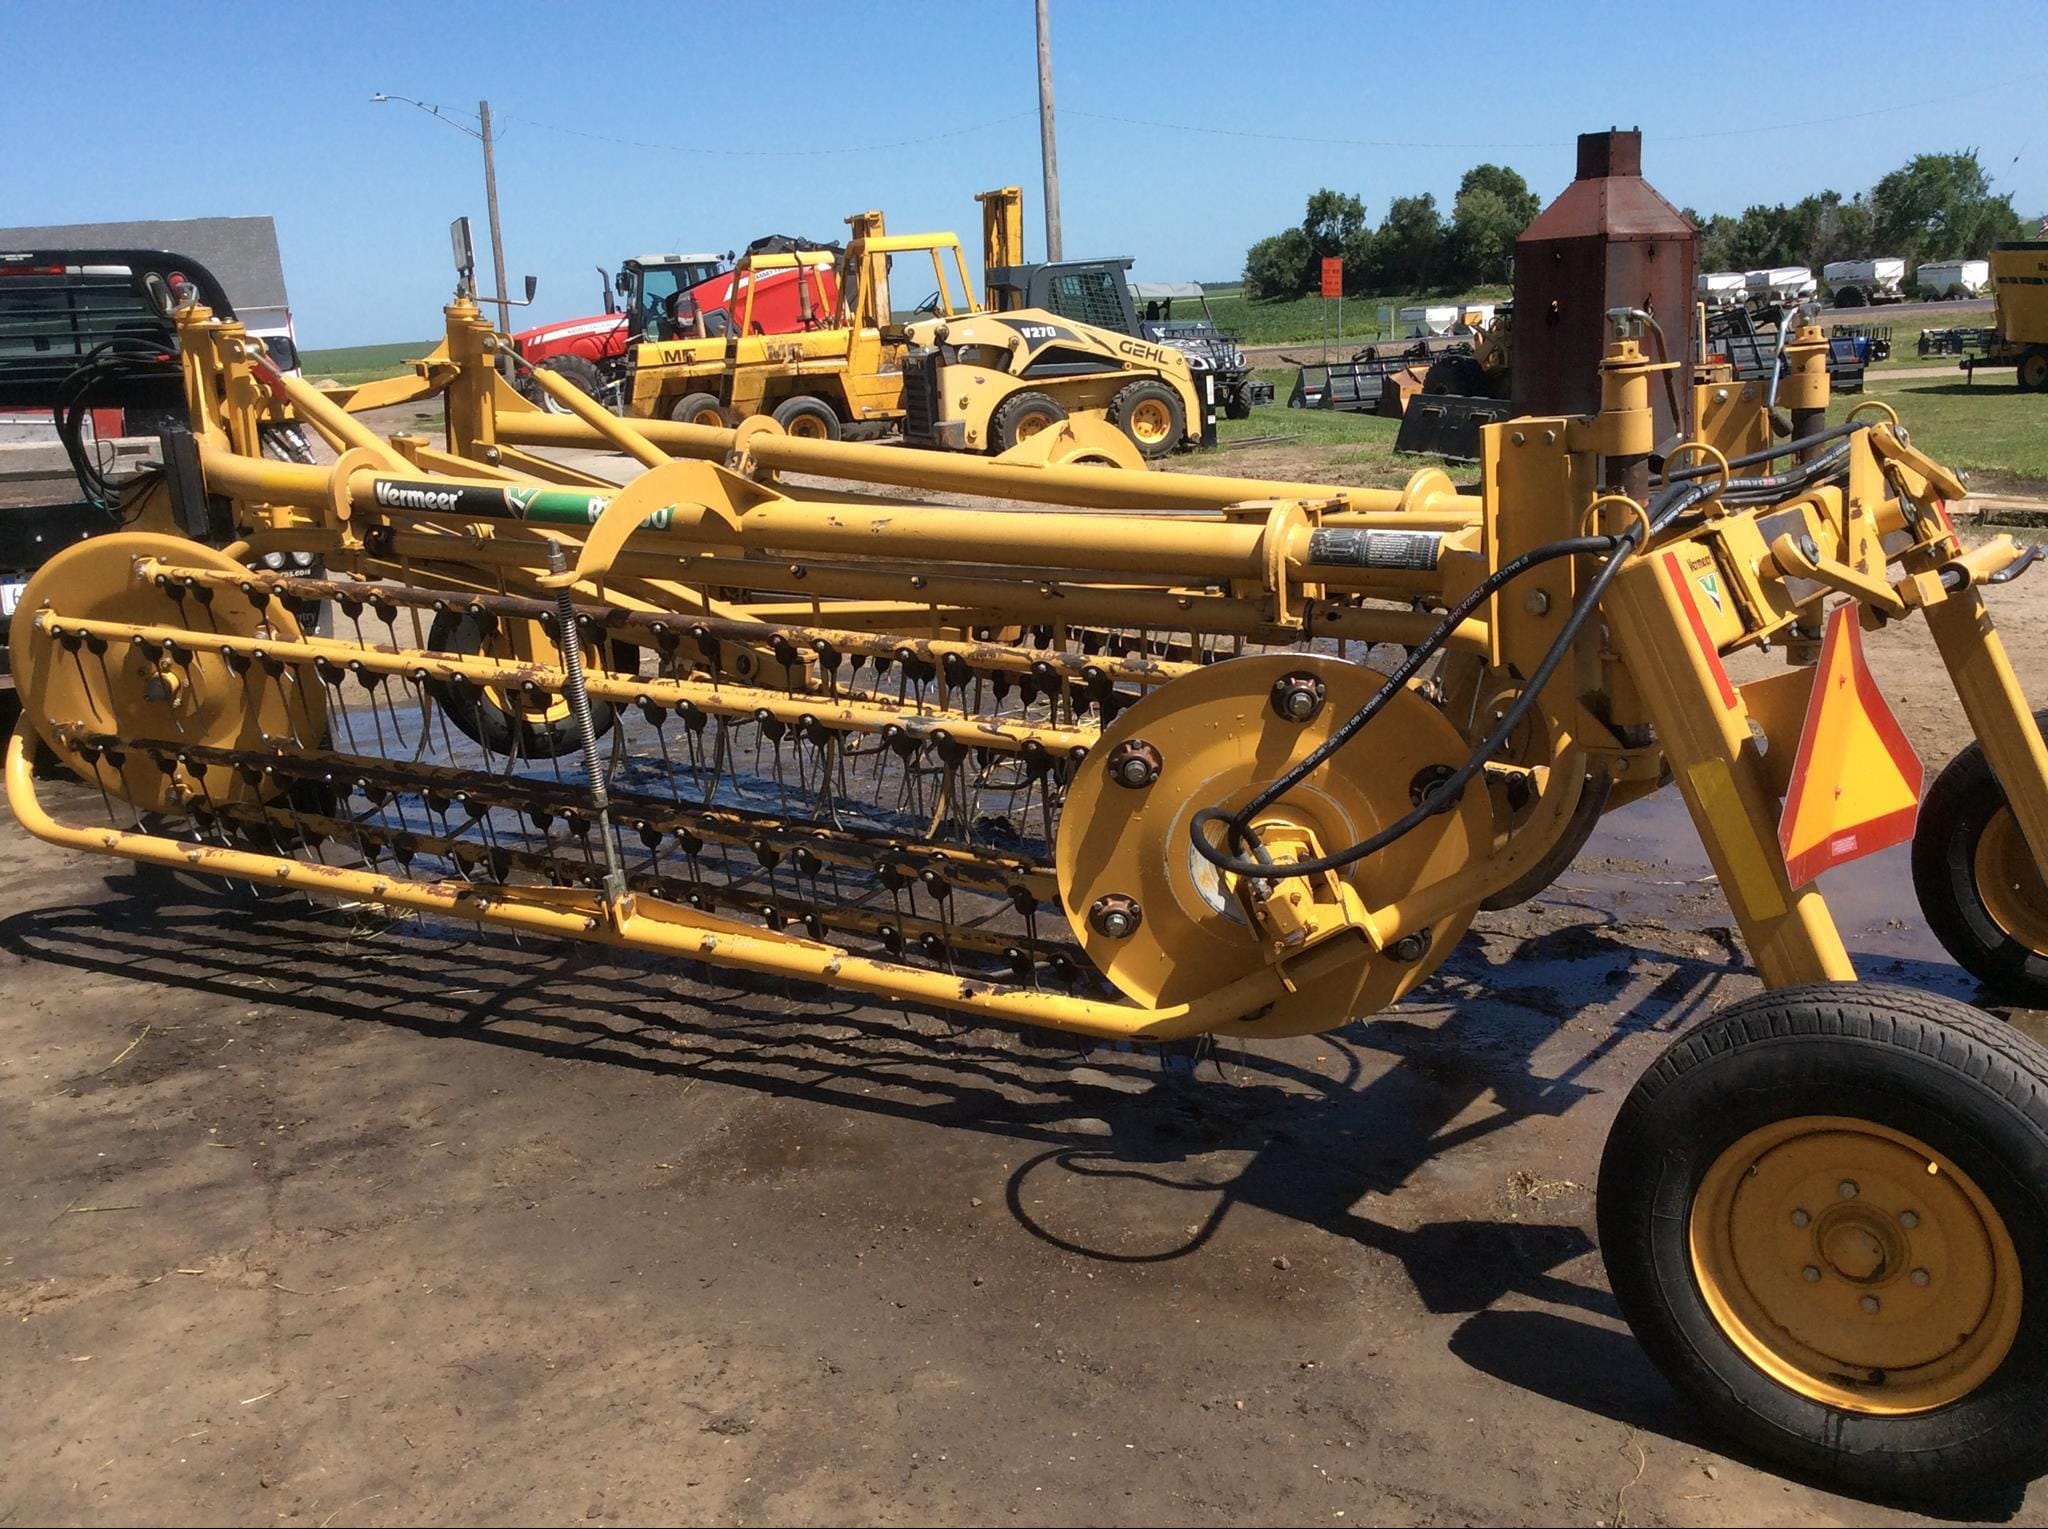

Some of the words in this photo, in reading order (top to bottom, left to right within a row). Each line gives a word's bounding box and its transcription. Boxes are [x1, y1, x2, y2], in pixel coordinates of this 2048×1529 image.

[1020, 326, 1056, 339] V270
[1119, 340, 1169, 364] GEHL
[376, 482, 459, 511] Vermeer
[1461, 586, 1485, 610] FORZA
[1446, 607, 1463, 624] DUE
[1350, 714, 1361, 726] ISO
